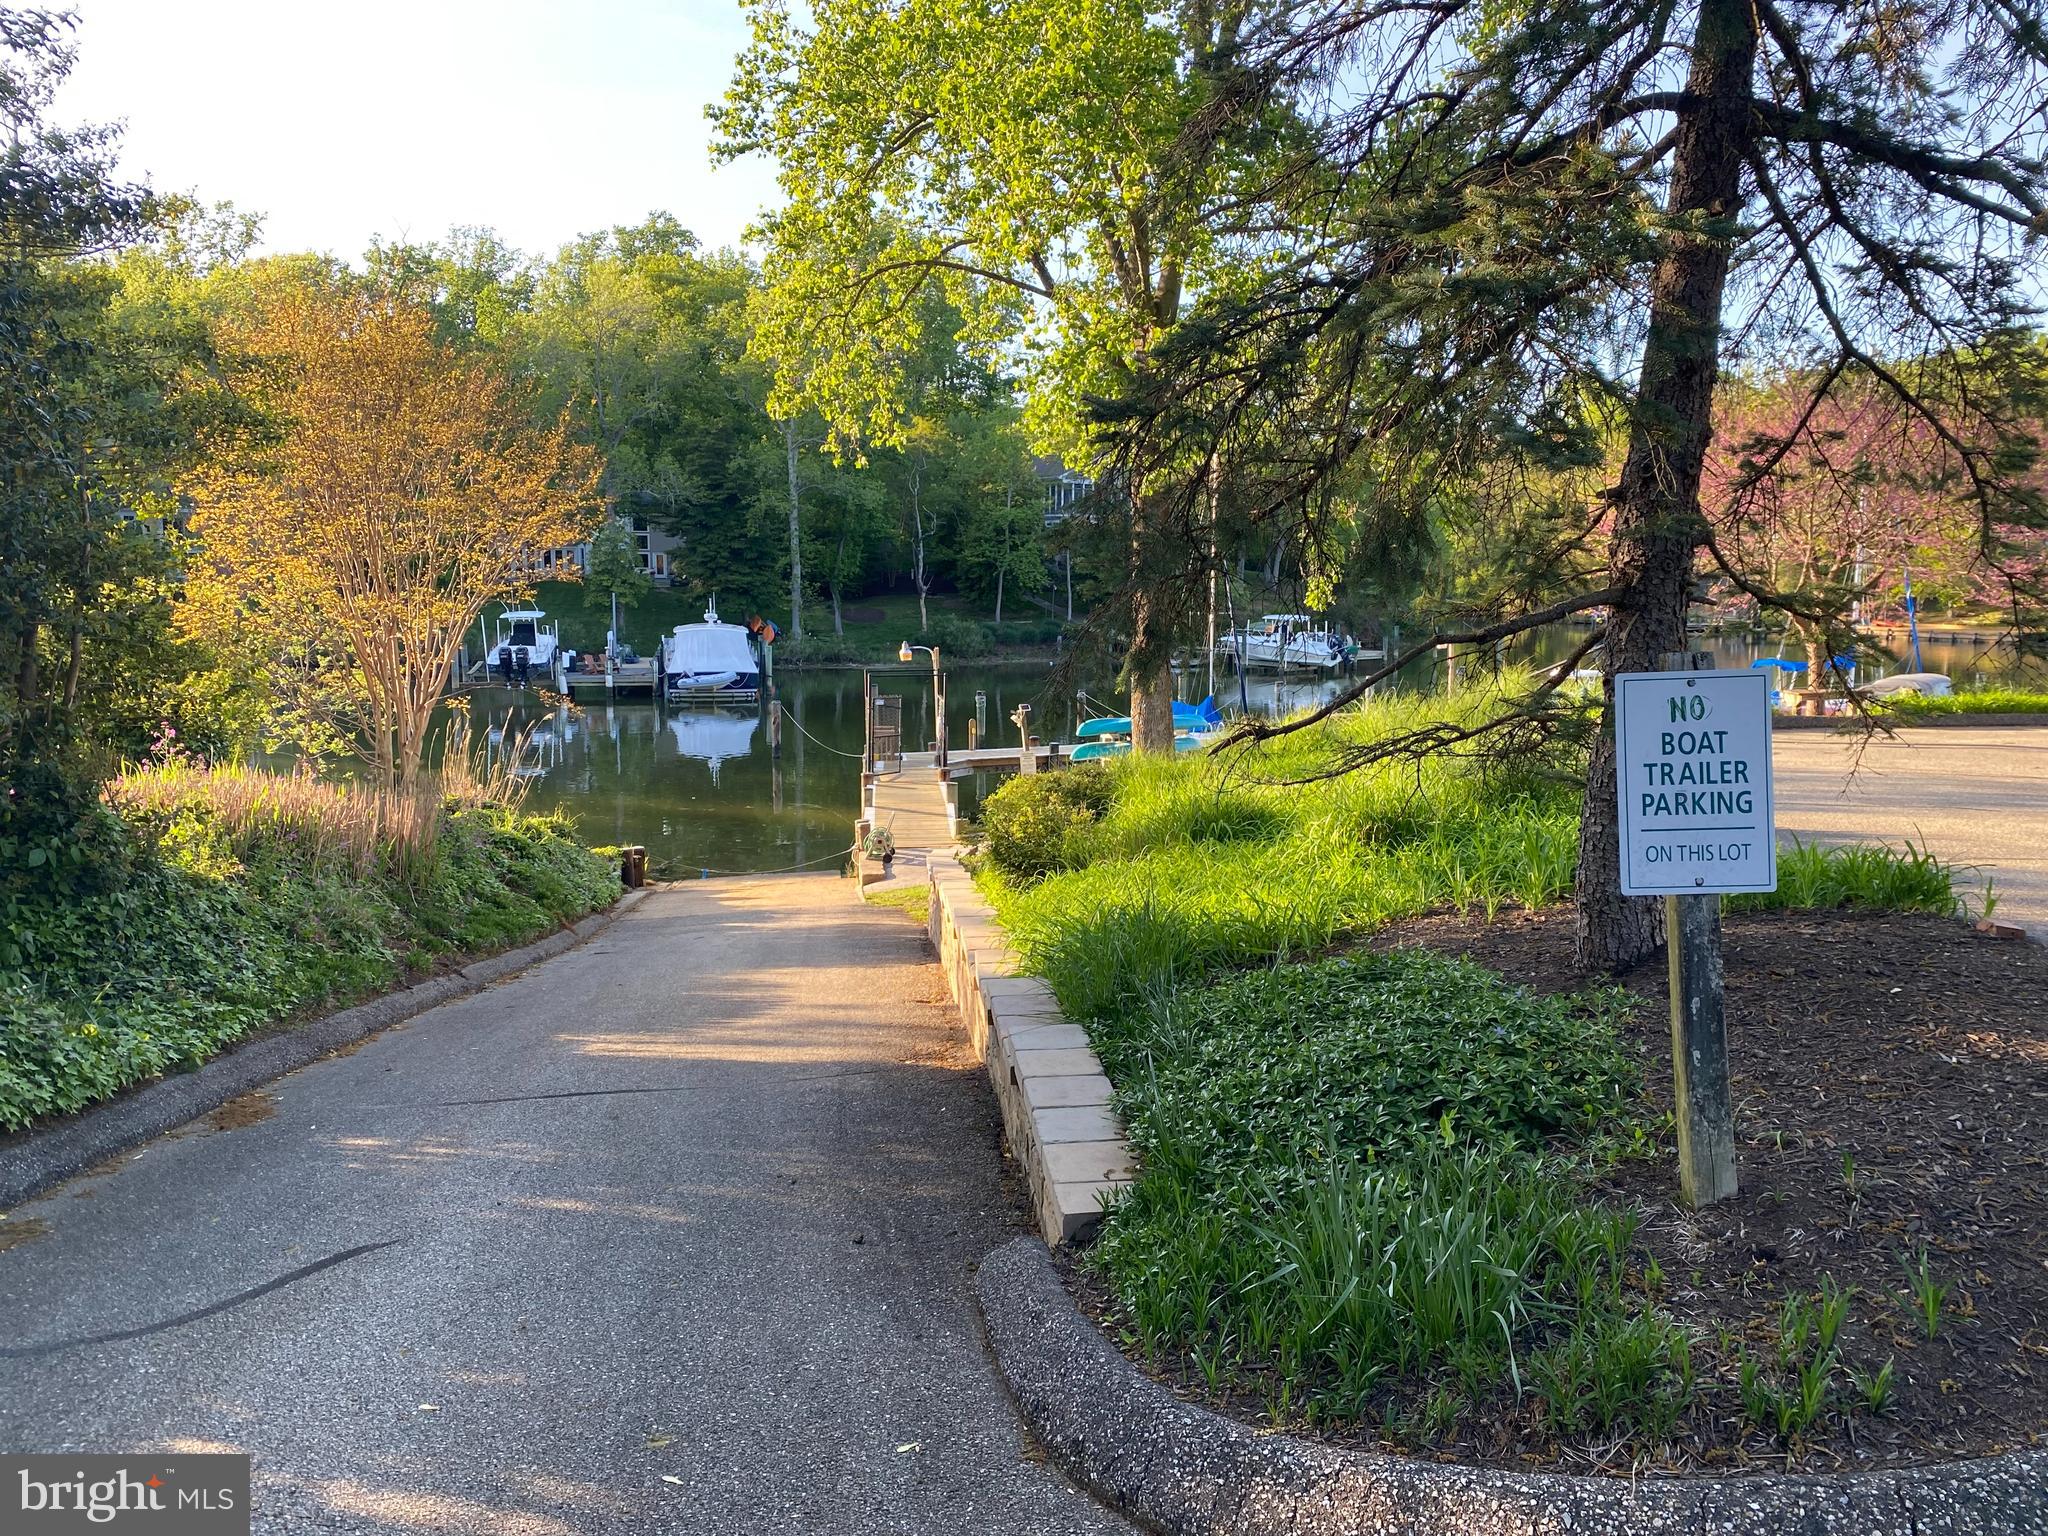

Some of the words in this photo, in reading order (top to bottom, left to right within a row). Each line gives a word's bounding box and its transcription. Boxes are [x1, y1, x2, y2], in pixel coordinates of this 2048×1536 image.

[1669, 694, 1706, 723] NO
[1661, 731, 1729, 755] BOAT
[1643, 760, 1749, 786] TRAILER
[1642, 790, 1753, 816] PARKING
[1645, 844, 1672, 862] ON
[1676, 844, 1714, 861] THIS
[1718, 843, 1752, 860] LOT
